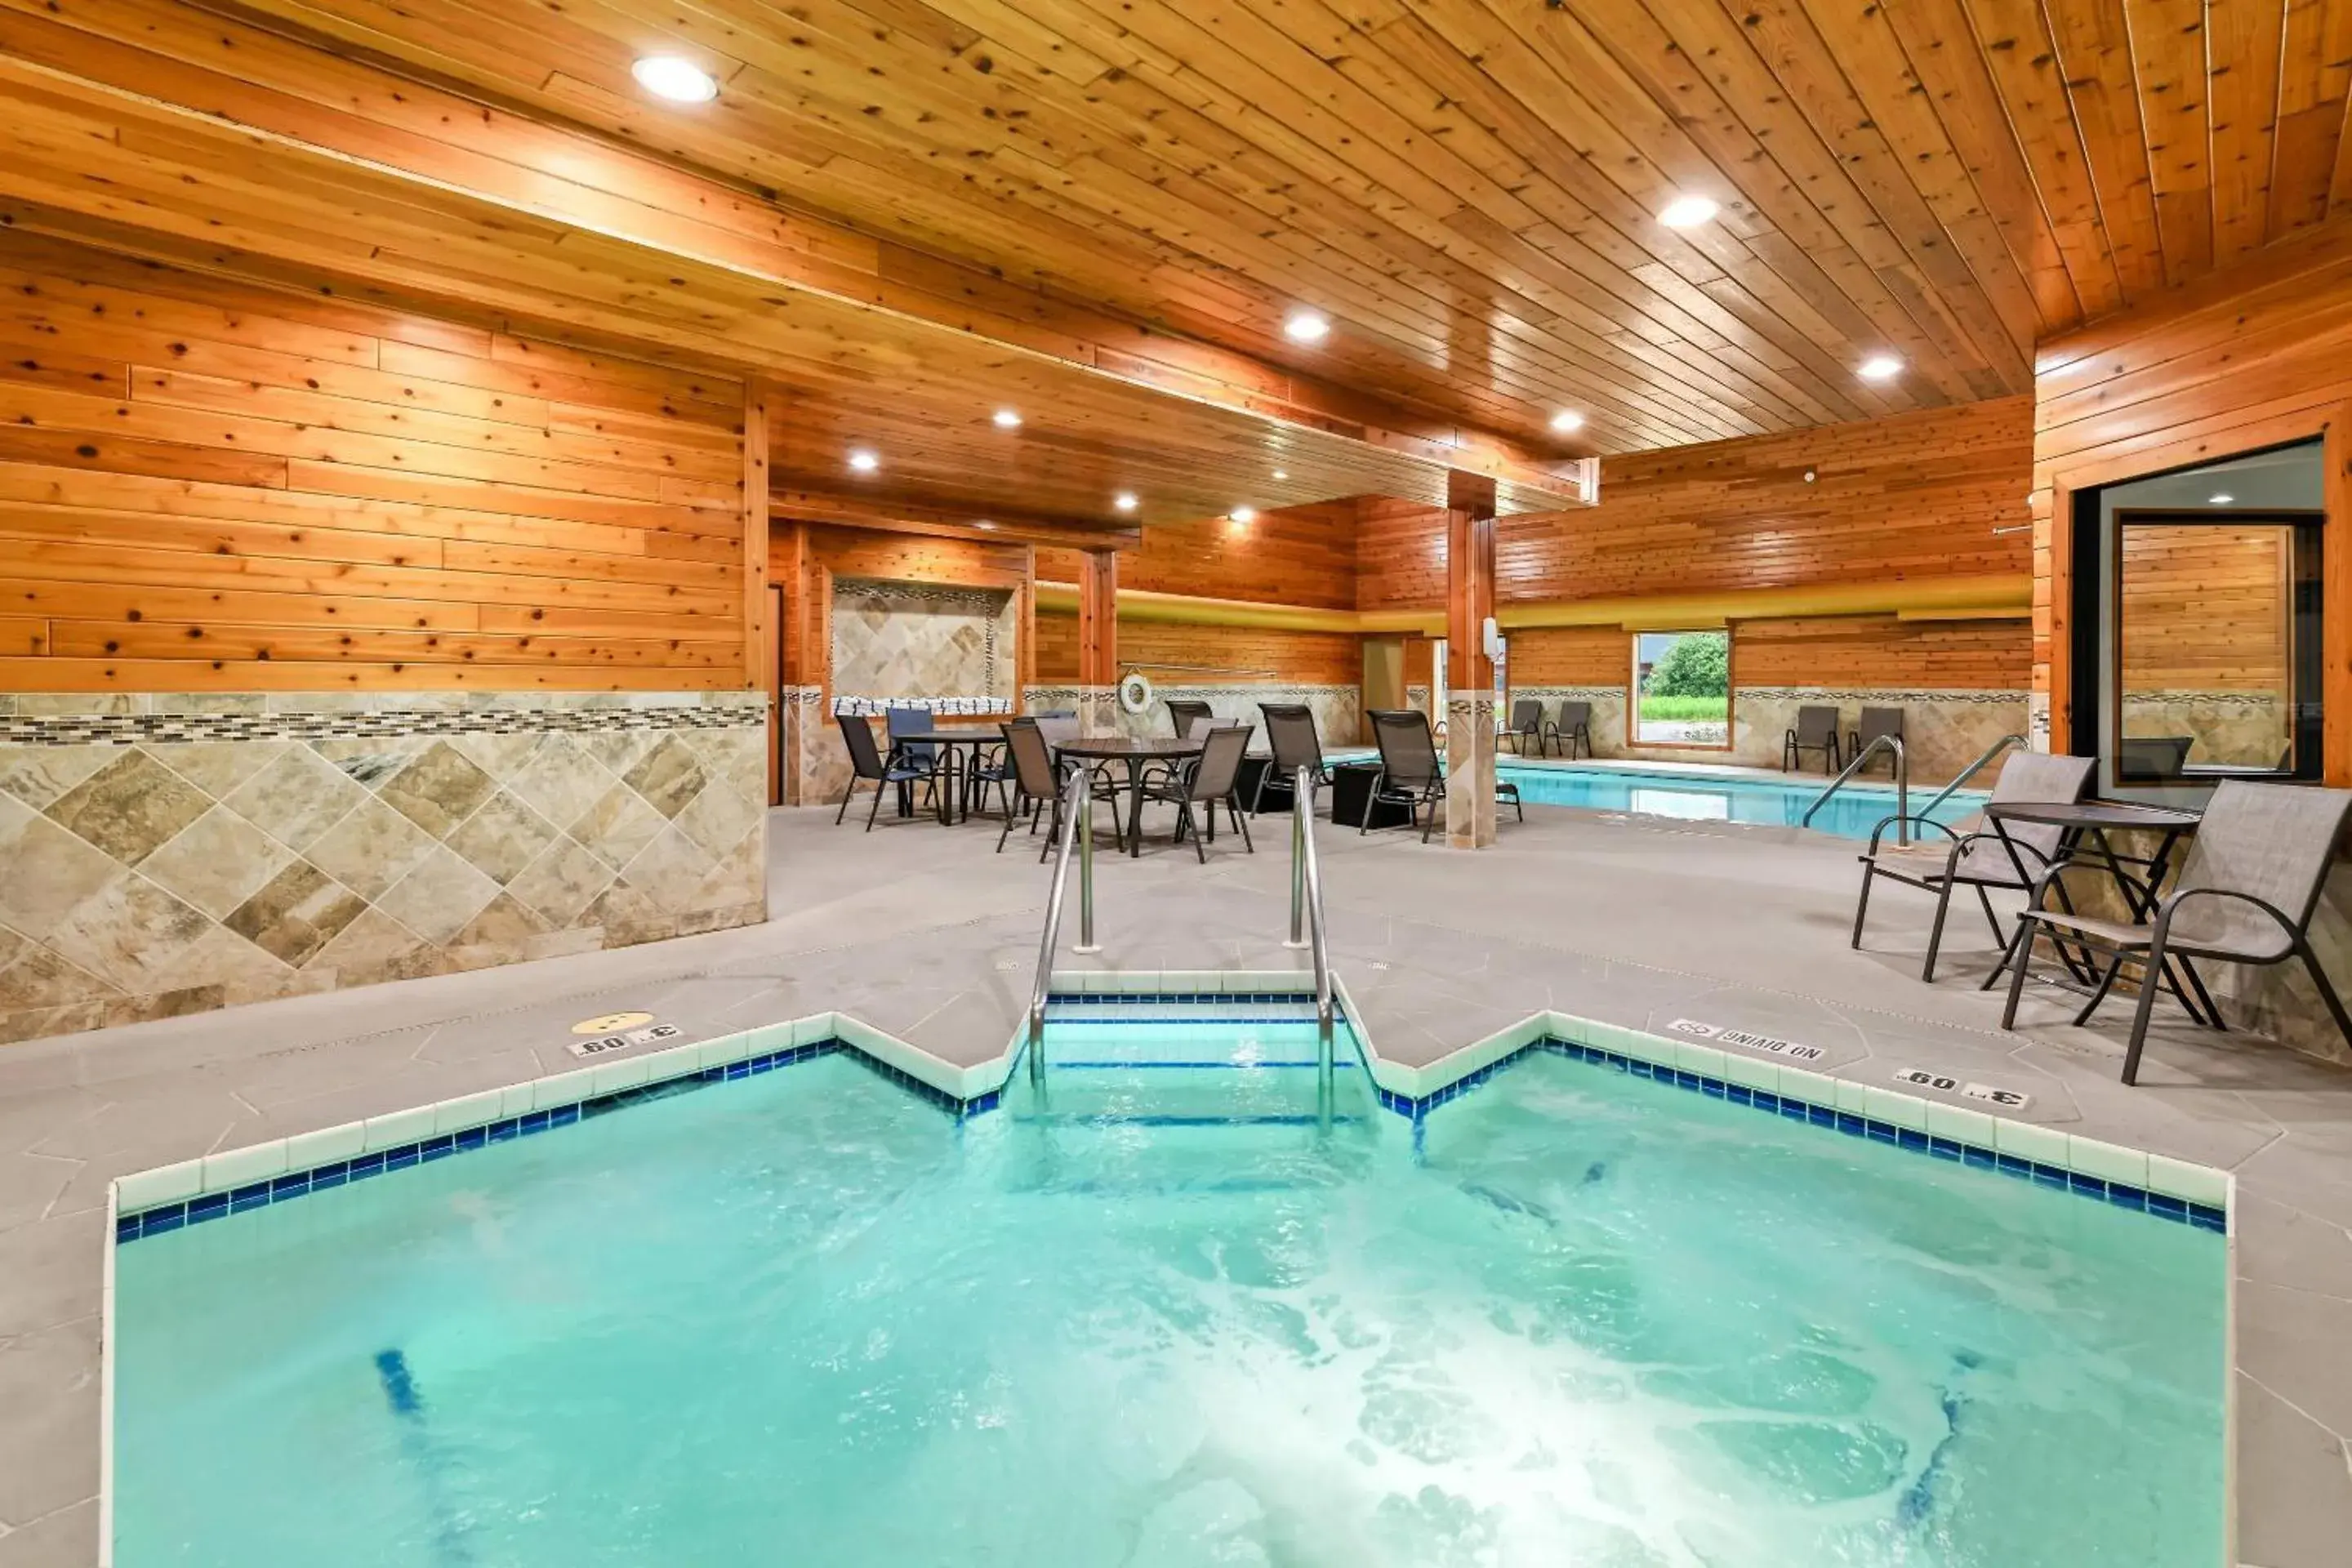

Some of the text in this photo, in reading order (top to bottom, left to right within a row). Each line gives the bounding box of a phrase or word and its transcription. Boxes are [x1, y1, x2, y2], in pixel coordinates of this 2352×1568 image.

[650, 1026, 677, 1037] 3
[1722, 1031, 1821, 1060] NO DIVING
[1991, 1090, 2024, 1105] 3
